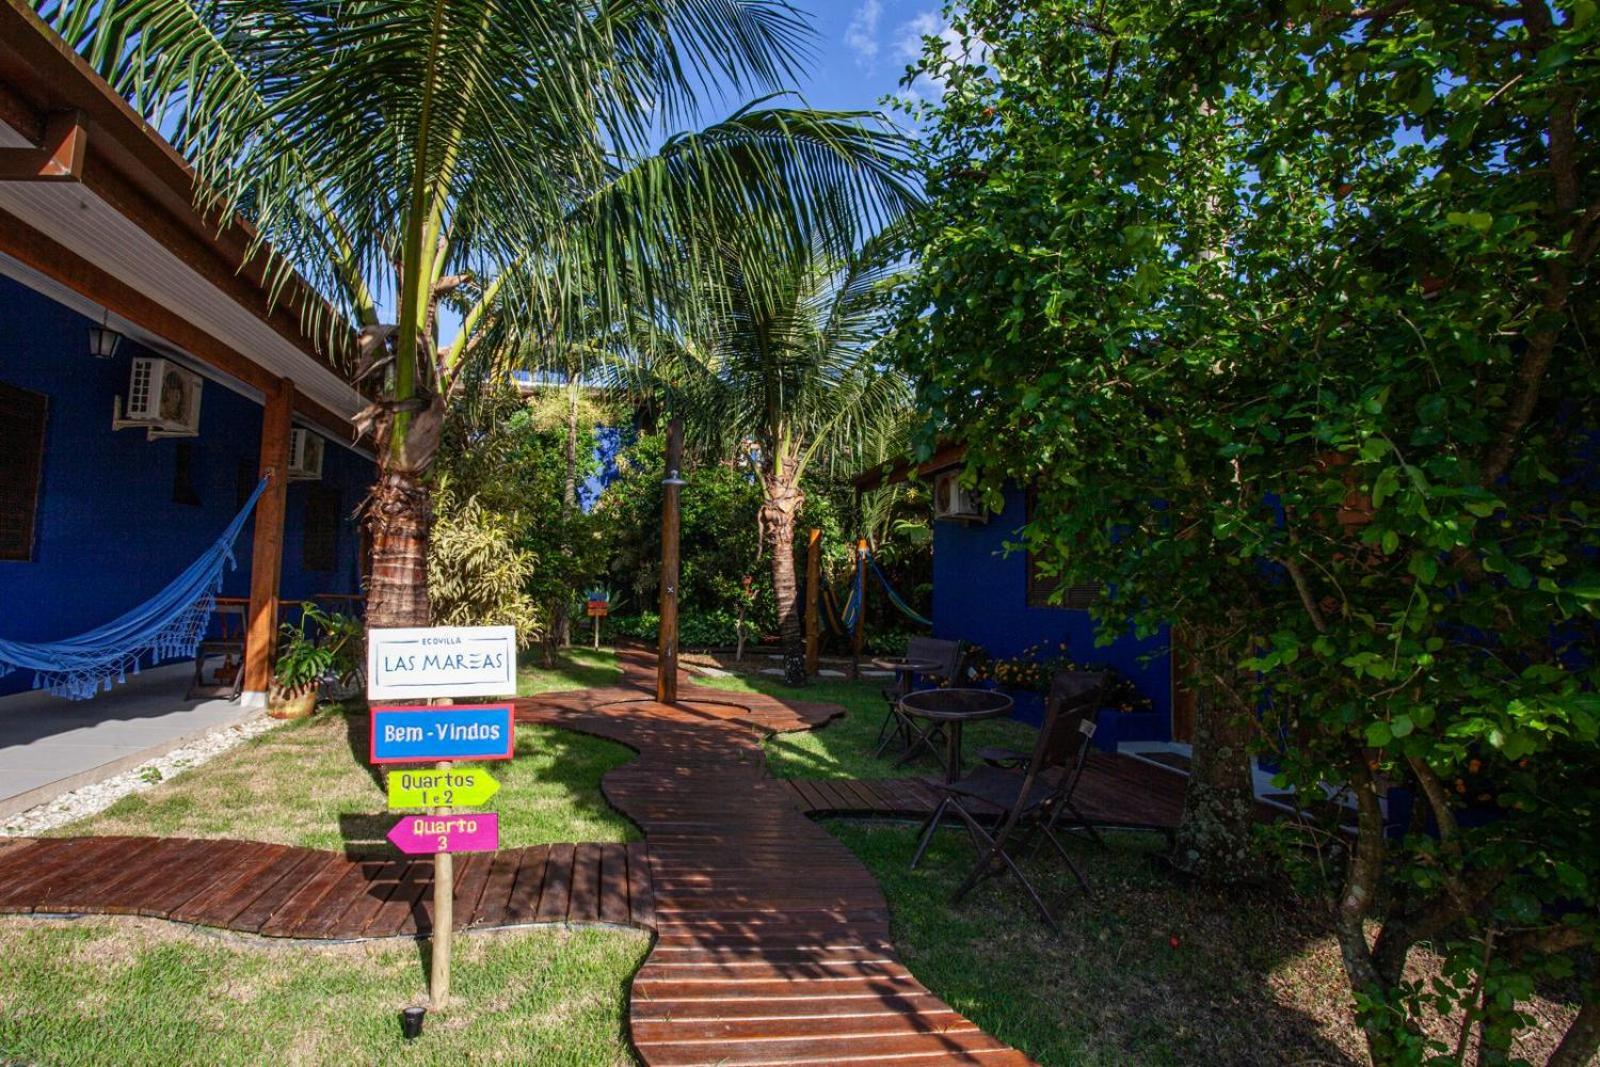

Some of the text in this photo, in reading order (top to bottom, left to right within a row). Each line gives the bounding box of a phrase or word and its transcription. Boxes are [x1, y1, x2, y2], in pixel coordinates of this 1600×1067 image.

[422, 637, 462, 646] ECOVILLA
[385, 656, 415, 672] LAS
[401, 774, 475, 789] Quartos
[444, 791, 453, 803] 2
[413, 819, 477, 836] Quarto
[438, 837, 448, 850] 3
